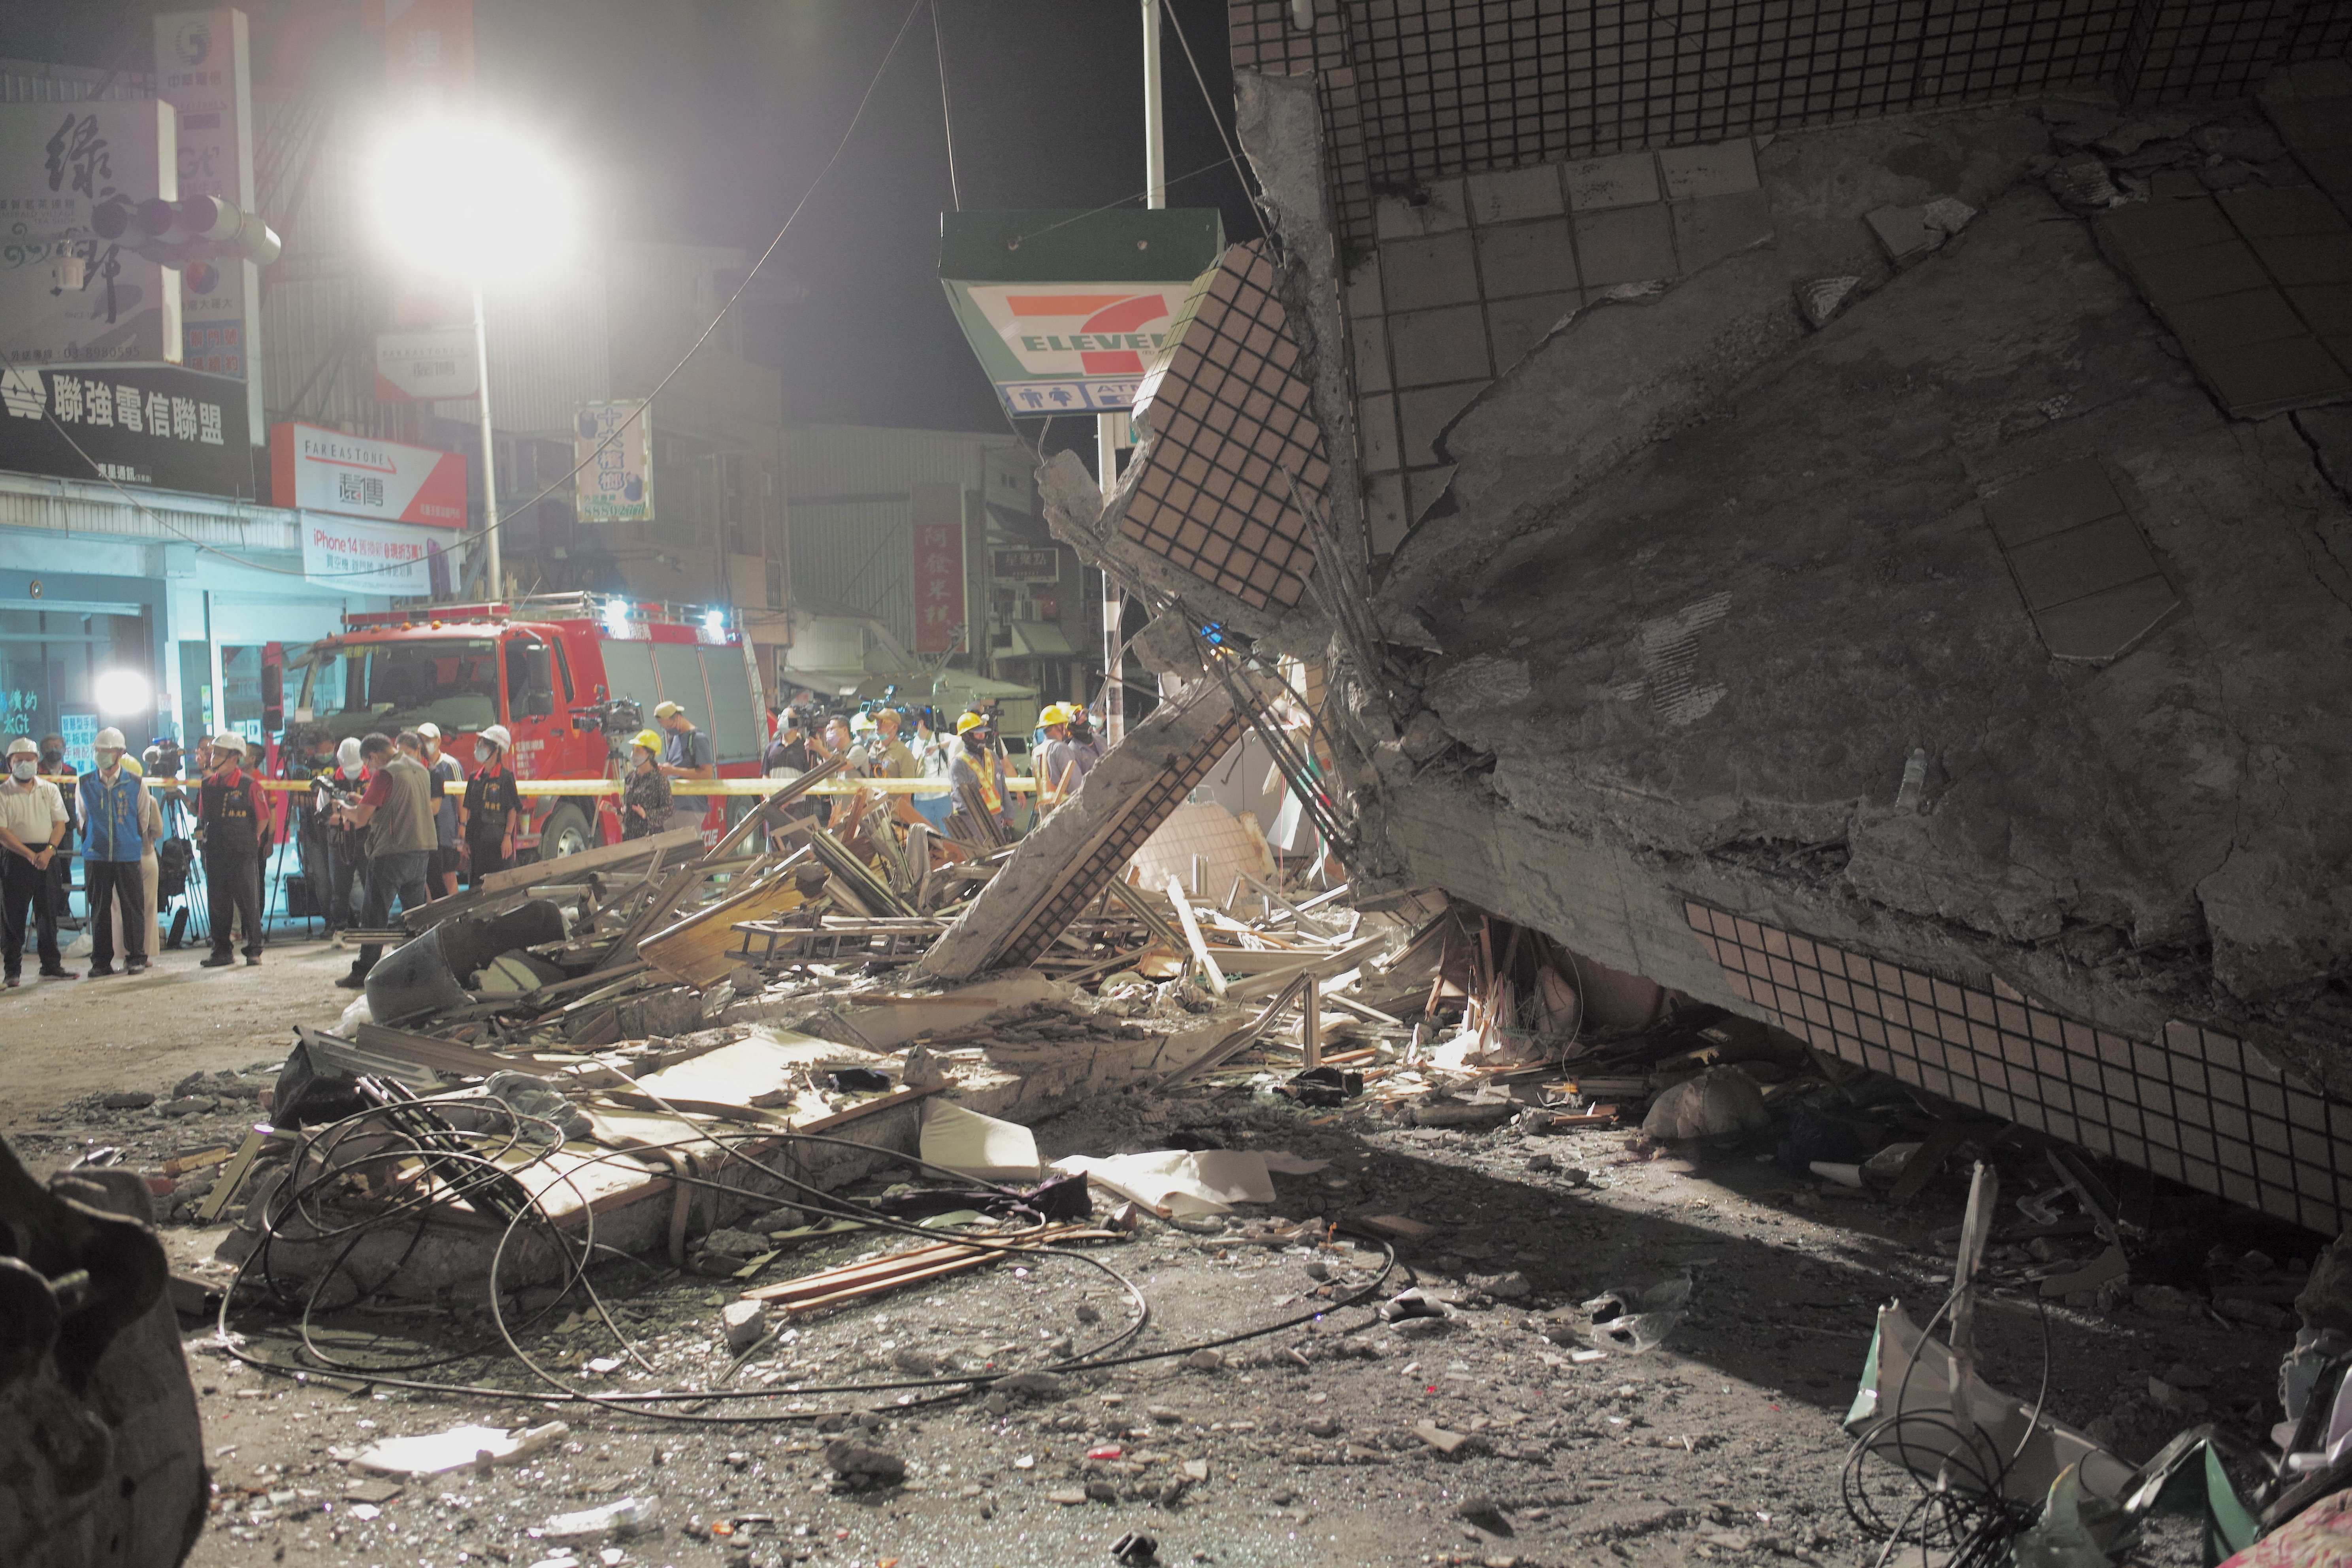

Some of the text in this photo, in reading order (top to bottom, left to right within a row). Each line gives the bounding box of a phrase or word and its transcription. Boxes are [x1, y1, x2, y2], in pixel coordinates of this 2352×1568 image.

[168, 70, 222, 88] 中華電信
[64, 346, 140, 359] 03-8980595
[53, 374, 224, 445] 聯強電信聯盟
[305, 439, 383, 466] FAREASTONE
[340, 473, 384, 507] 遠傳
[314, 528, 346, 553] iPhone
[348, 537, 358, 554] 14
